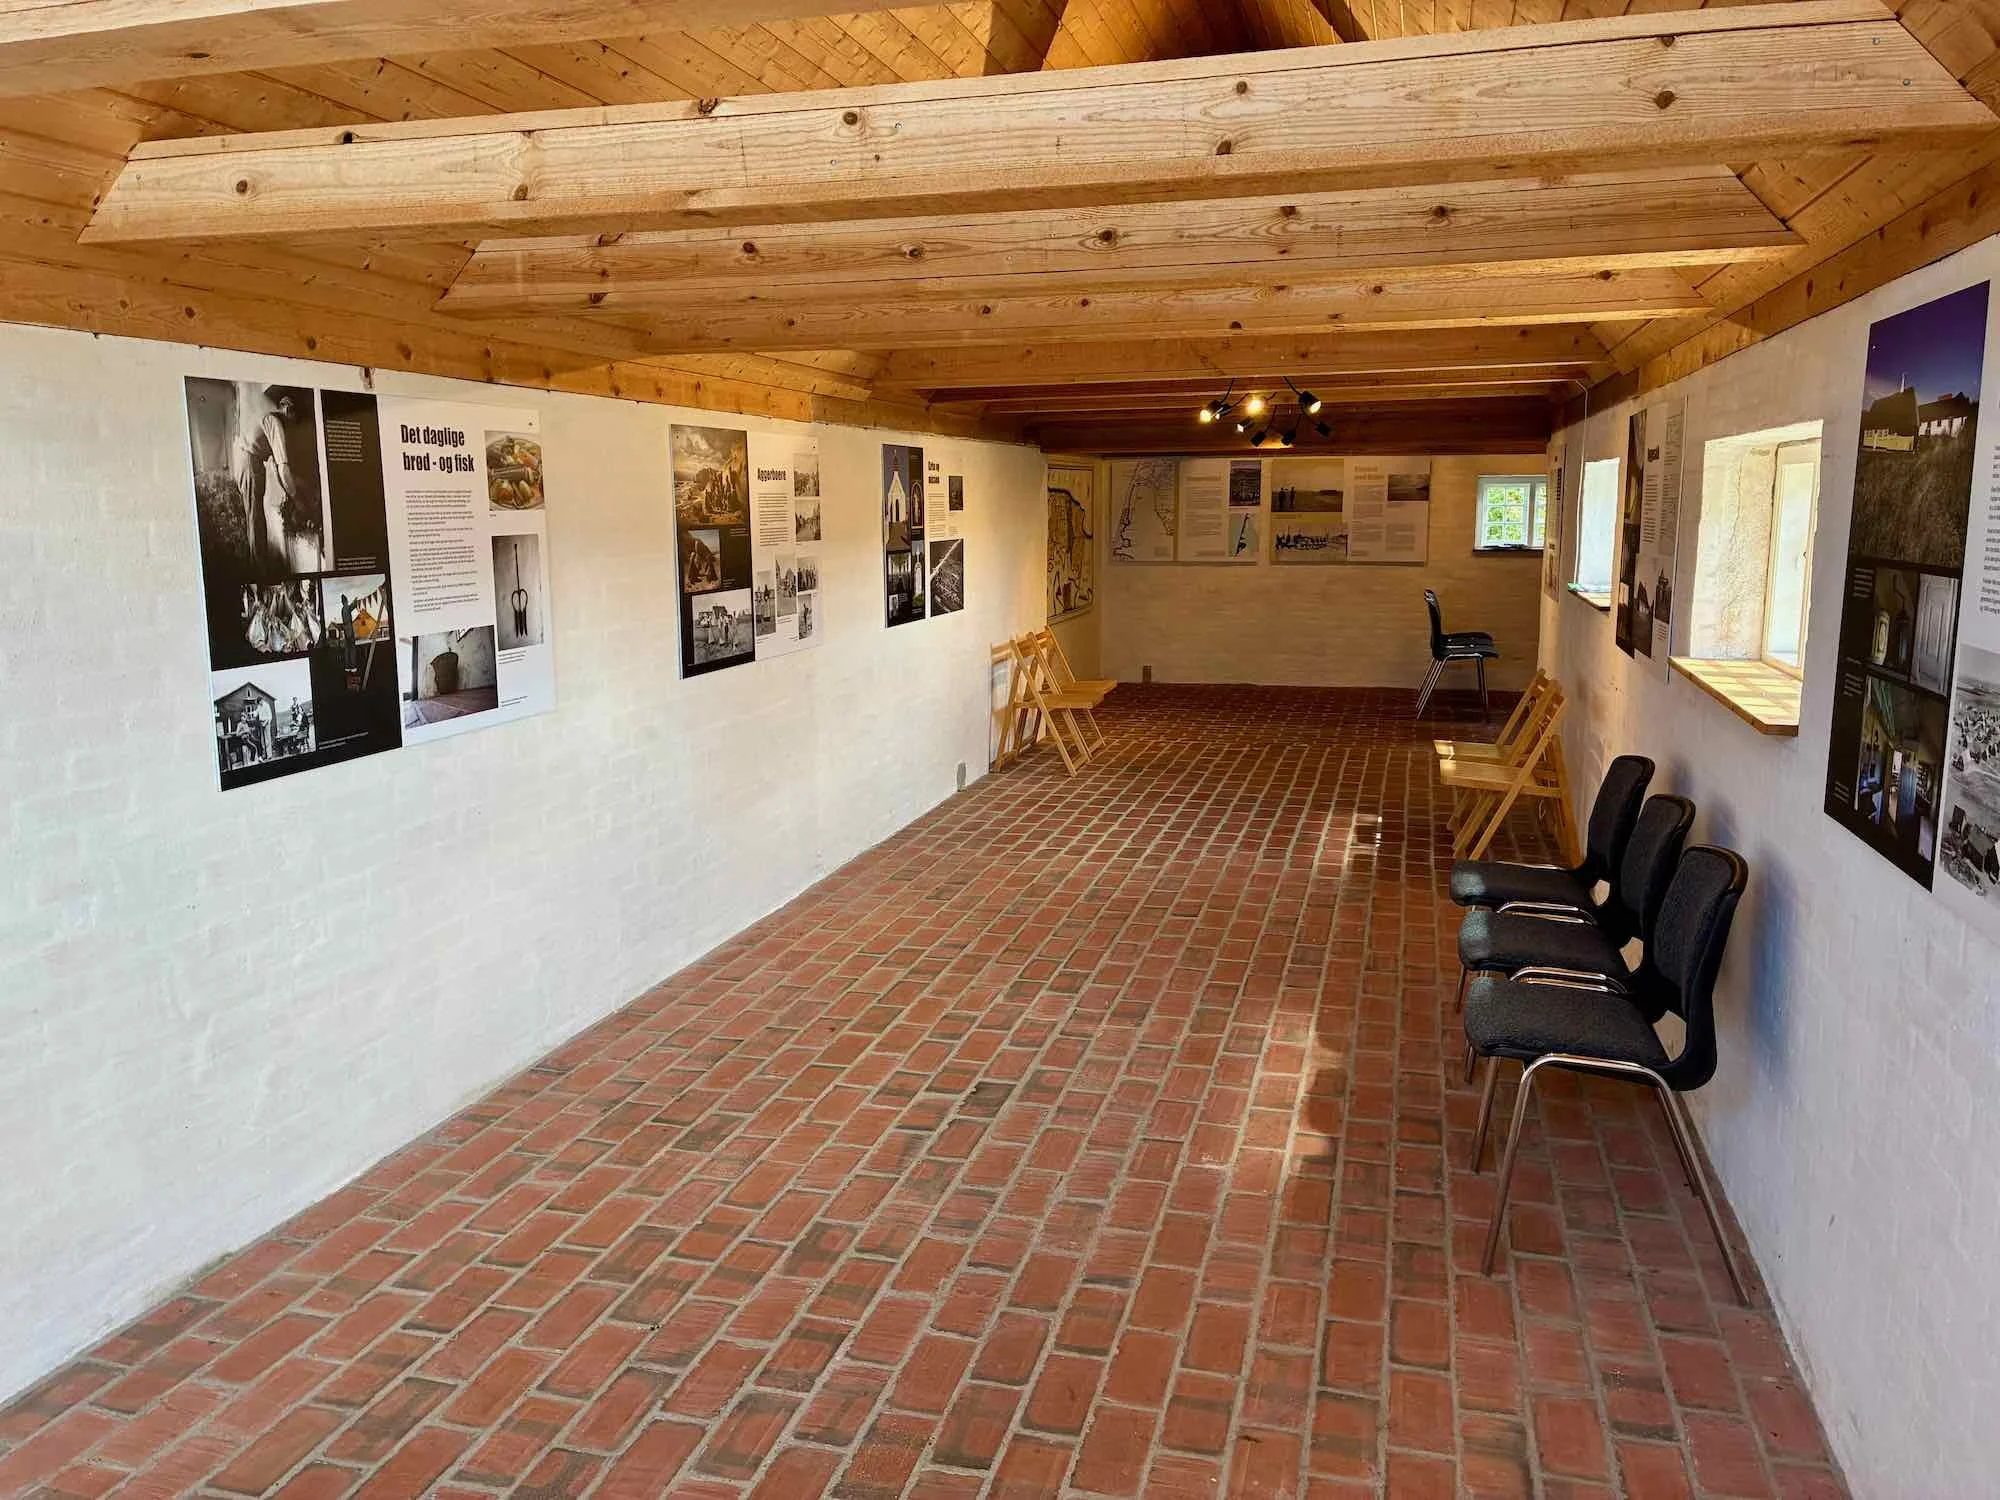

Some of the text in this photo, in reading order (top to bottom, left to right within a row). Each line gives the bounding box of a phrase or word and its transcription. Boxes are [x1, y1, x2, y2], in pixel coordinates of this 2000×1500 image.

[400, 424, 465, 448] Det daglige
[402, 451, 430, 471] brød
[439, 456, 453, 473] og
[454, 453, 475, 472] fisk
